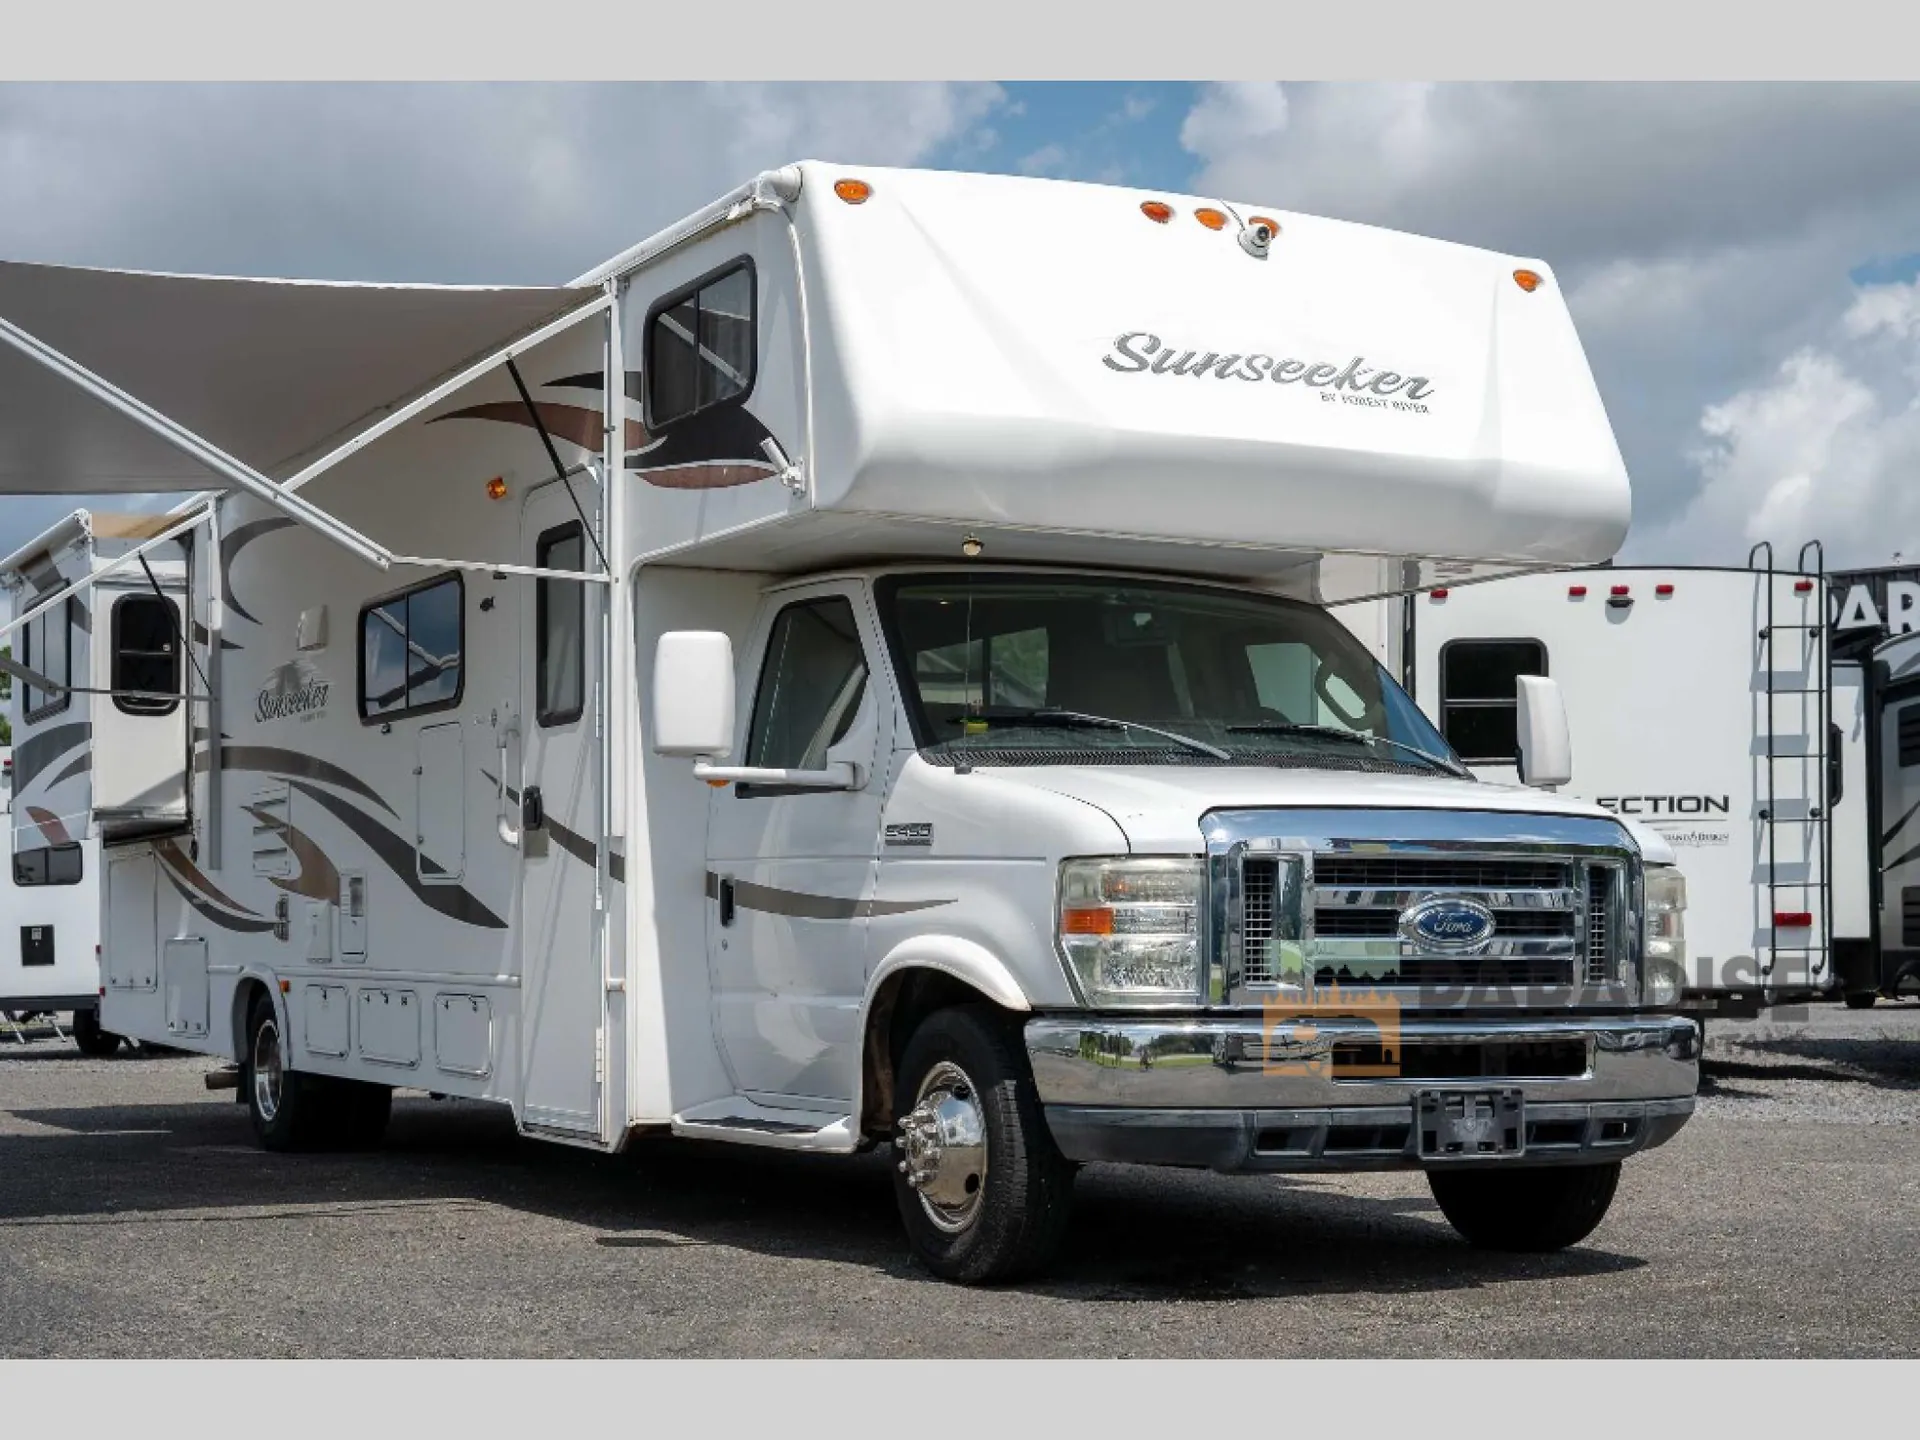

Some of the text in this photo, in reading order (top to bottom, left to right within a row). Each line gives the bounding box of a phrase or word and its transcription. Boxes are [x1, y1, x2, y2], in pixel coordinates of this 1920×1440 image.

[1102, 332, 1435, 400] Sunseeker
[1341, 393, 1388, 409] FOREST
[1391, 400, 1430, 413] RIVER
[1831, 581, 1920, 634] AR
[255, 677, 329, 723] Sunseeker
[1433, 912, 1474, 933] Ford
